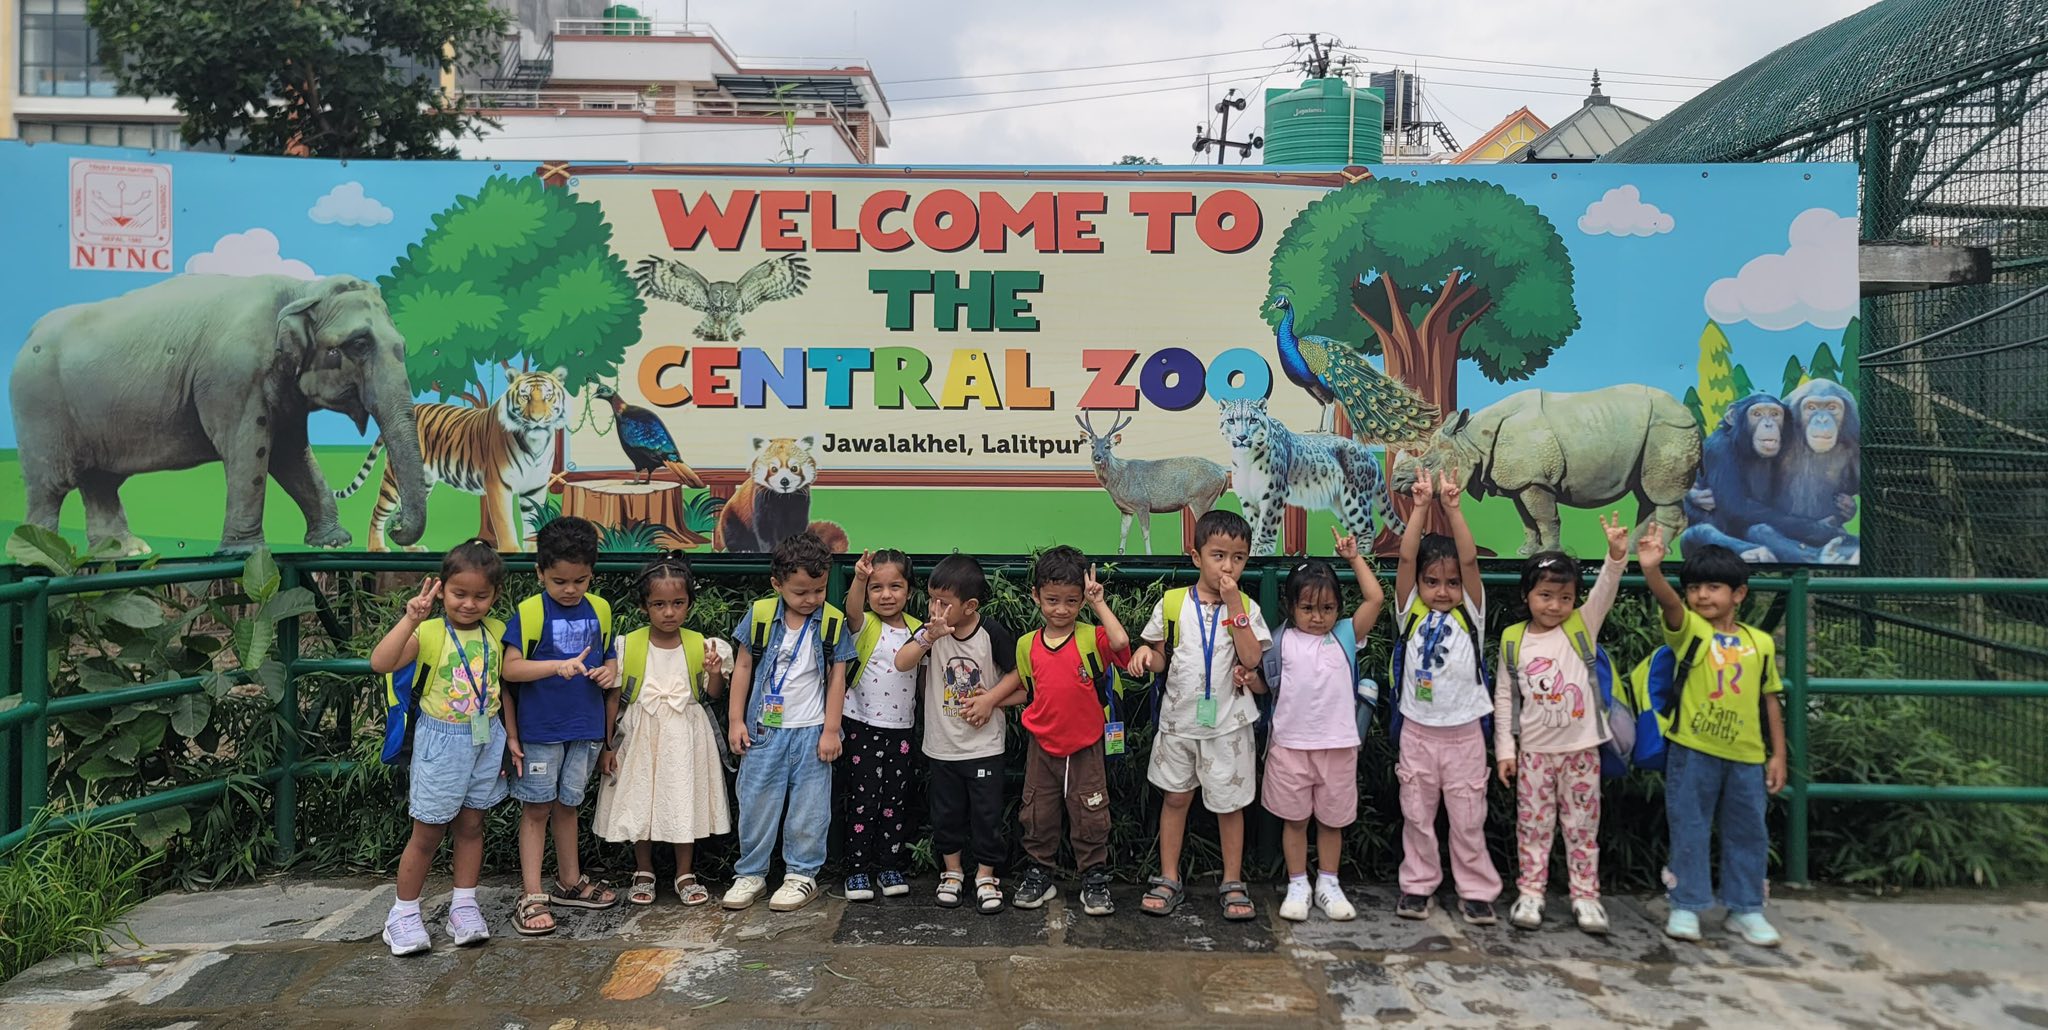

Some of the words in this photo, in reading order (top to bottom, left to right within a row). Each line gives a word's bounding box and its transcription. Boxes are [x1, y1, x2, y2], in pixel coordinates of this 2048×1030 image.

[652, 189, 1107, 252] WELCOME
[1129, 190, 1263, 253] TO
[76, 246, 169, 270] NTNC
[868, 270, 1042, 332] THE
[637, 345, 1054, 410] CENTRAL
[1078, 347, 1273, 410] ZOO
[822, 433, 973, 456] Jawalakhel,
[981, 434, 1087, 458] Lalitpur
